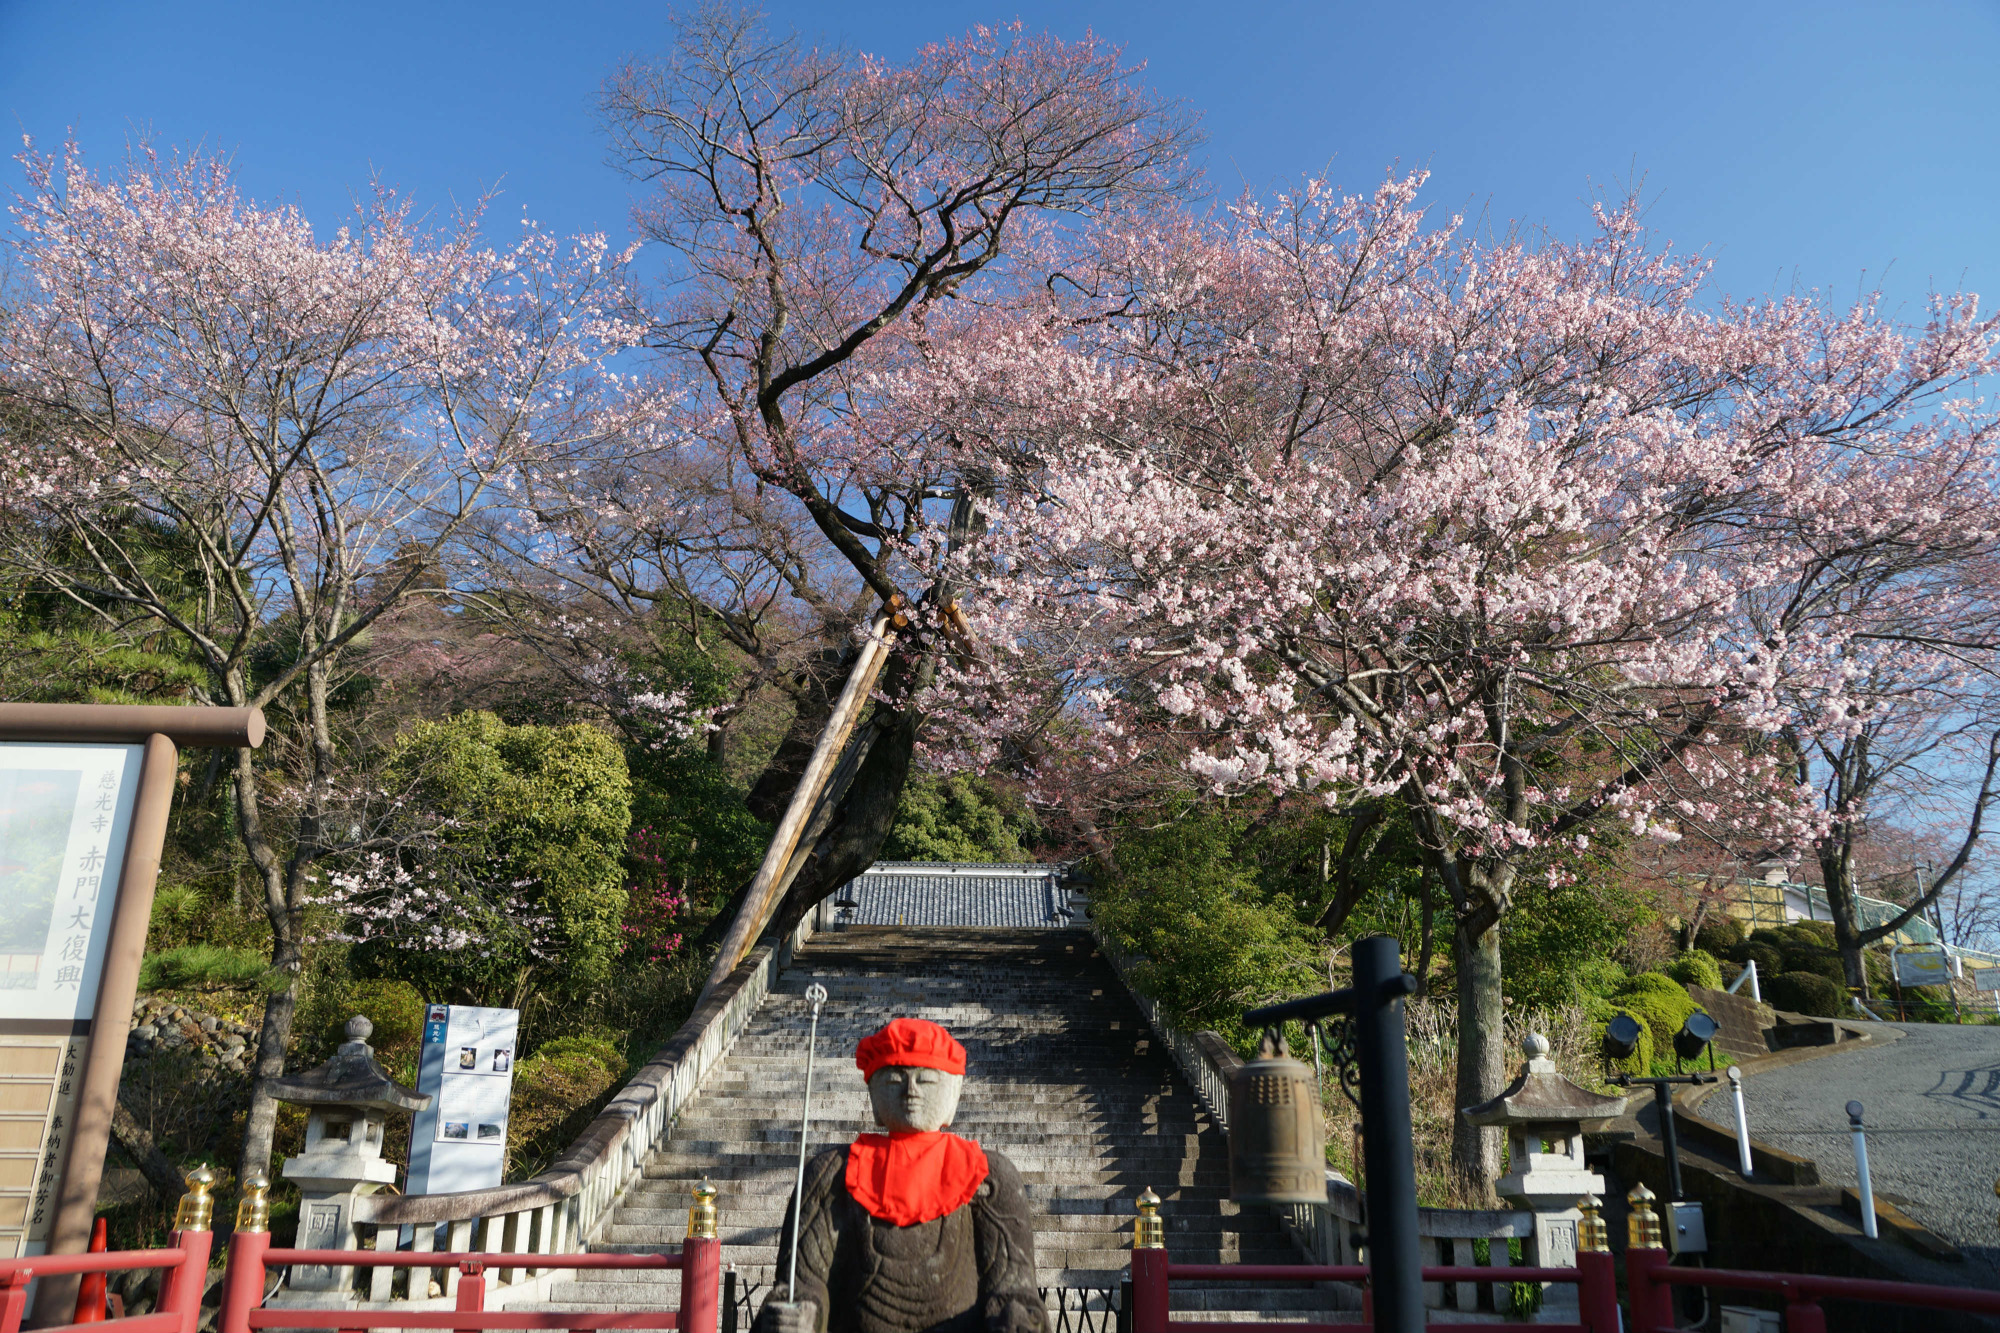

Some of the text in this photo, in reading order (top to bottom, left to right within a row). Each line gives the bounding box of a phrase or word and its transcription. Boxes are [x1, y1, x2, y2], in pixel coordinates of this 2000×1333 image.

[53, 770, 116, 992] 慈光寺 赤門大復興
[31, 1115, 64, 1225] 奉納者御芳名
